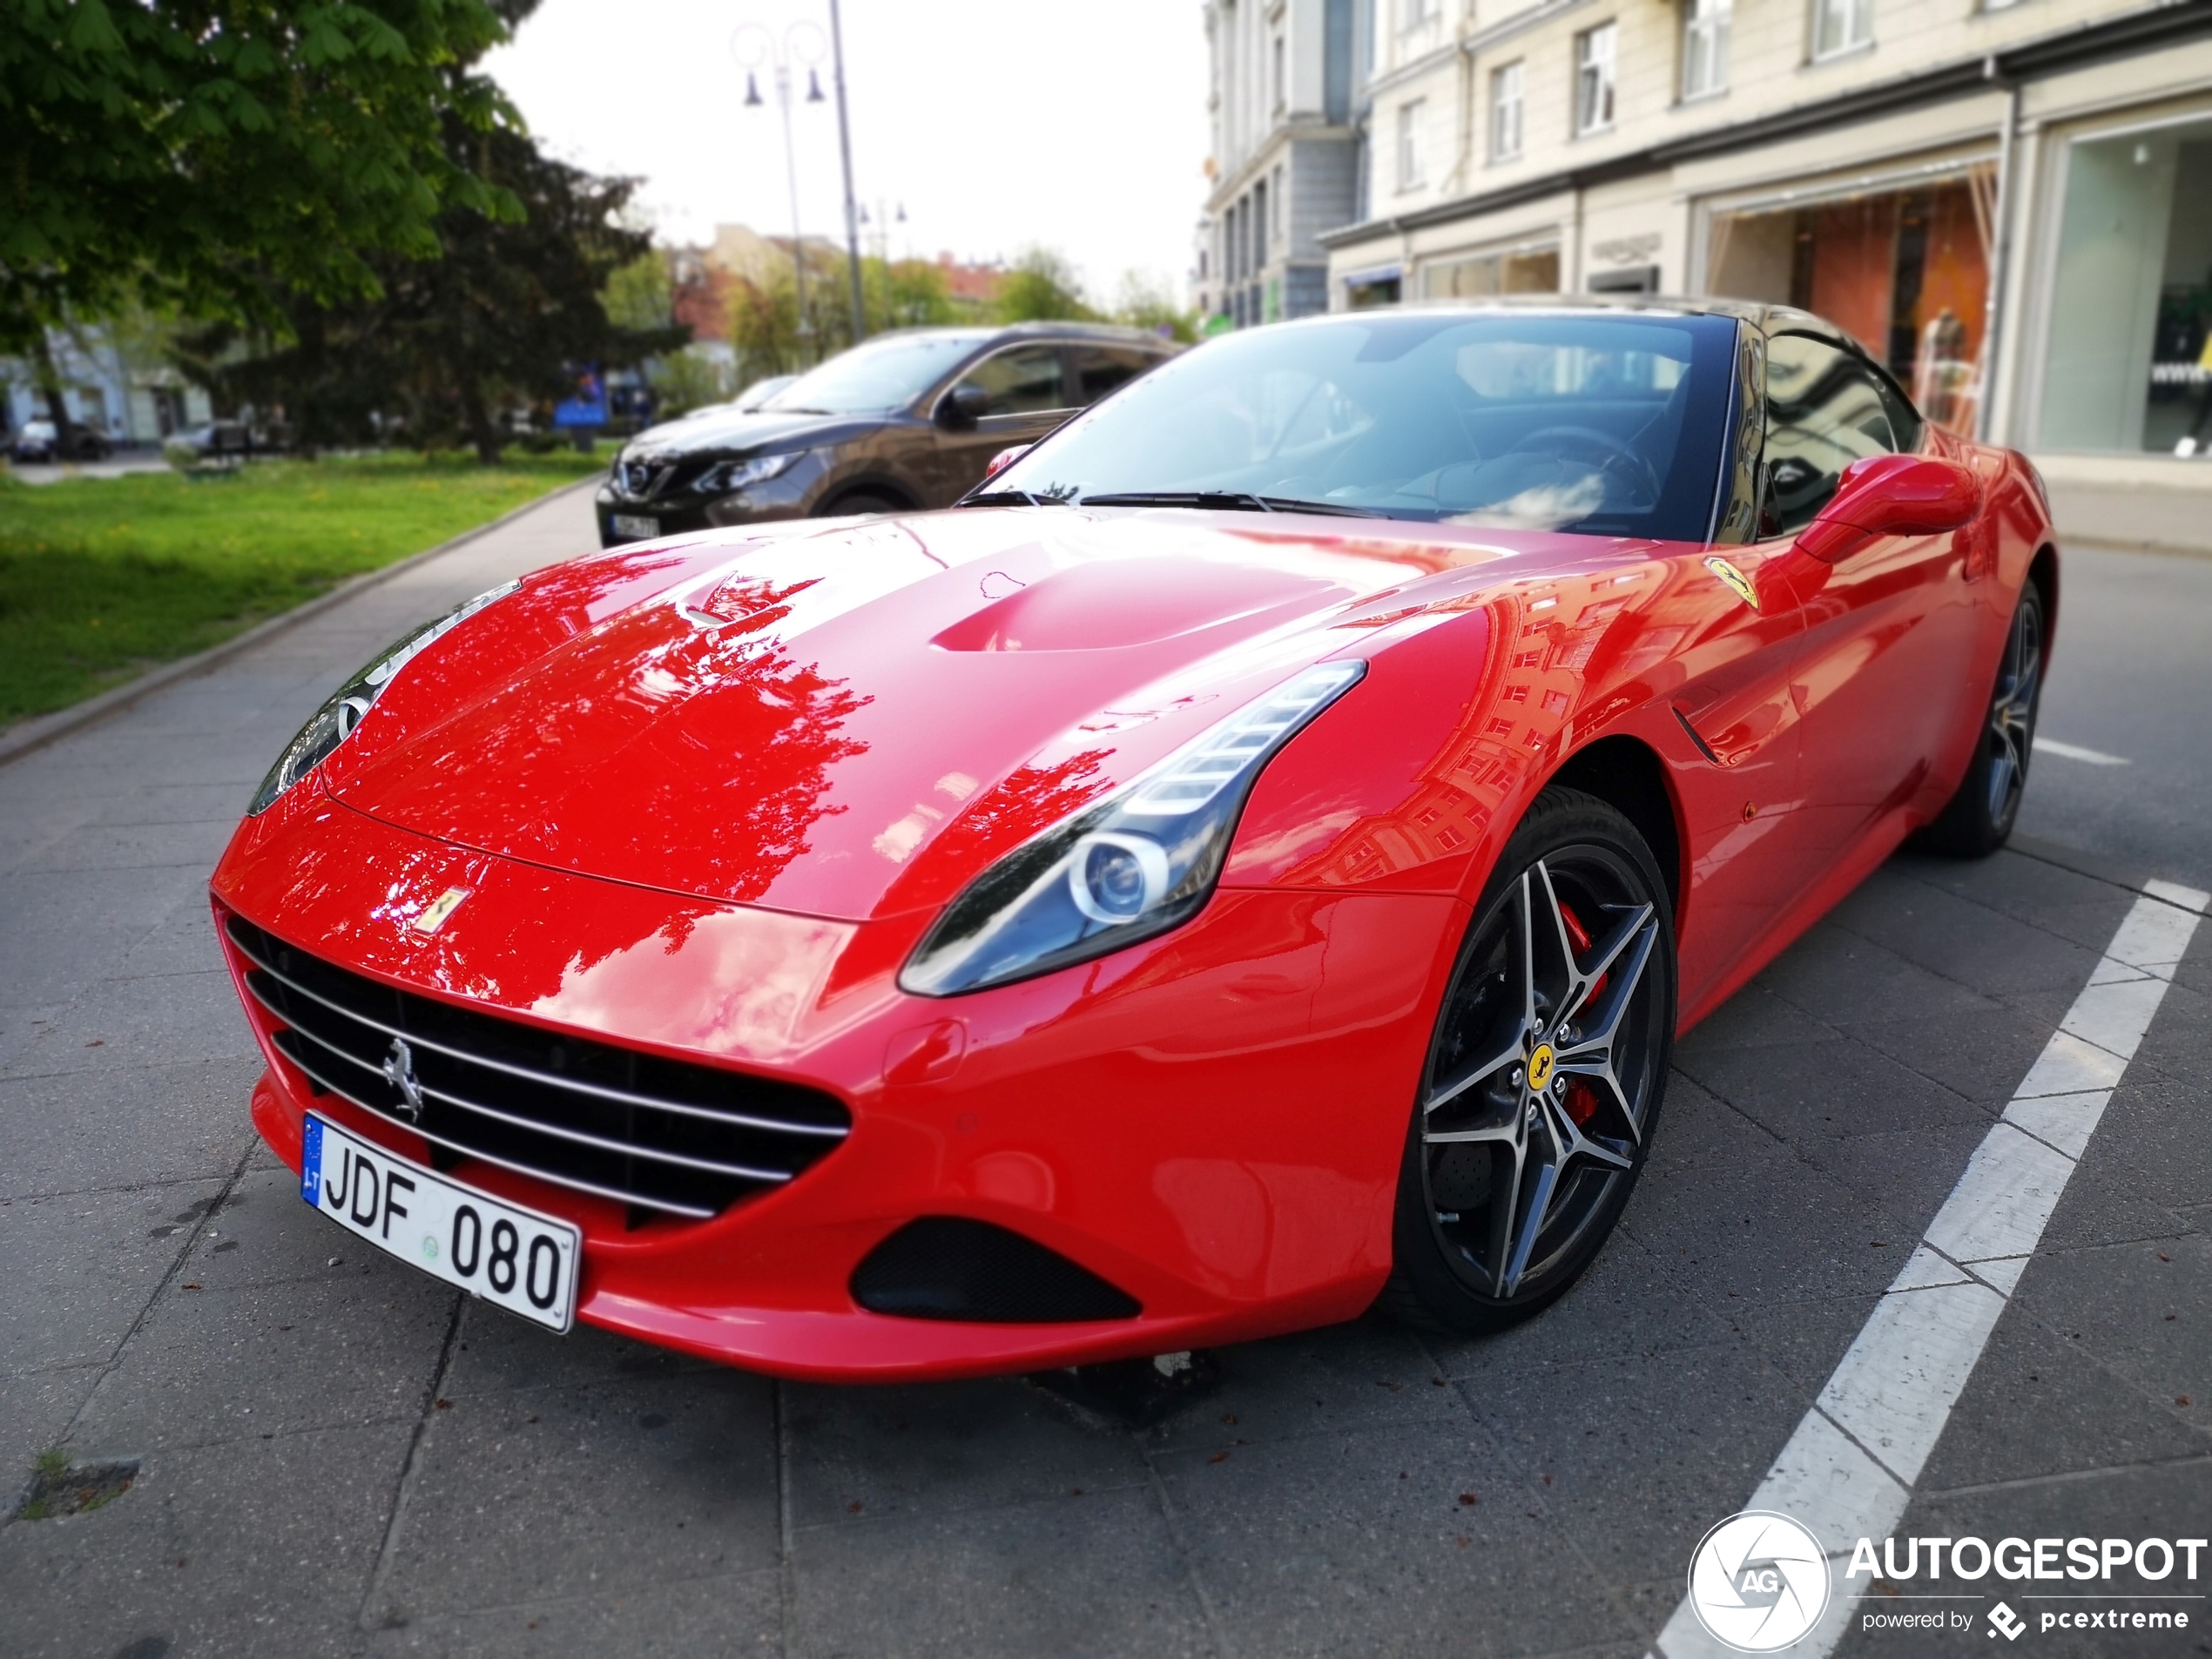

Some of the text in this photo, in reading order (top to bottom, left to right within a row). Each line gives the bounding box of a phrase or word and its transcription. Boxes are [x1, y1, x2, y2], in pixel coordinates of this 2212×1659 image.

[305, 1167, 320, 1190] LT
[325, 1147, 561, 1309] JDF 080
